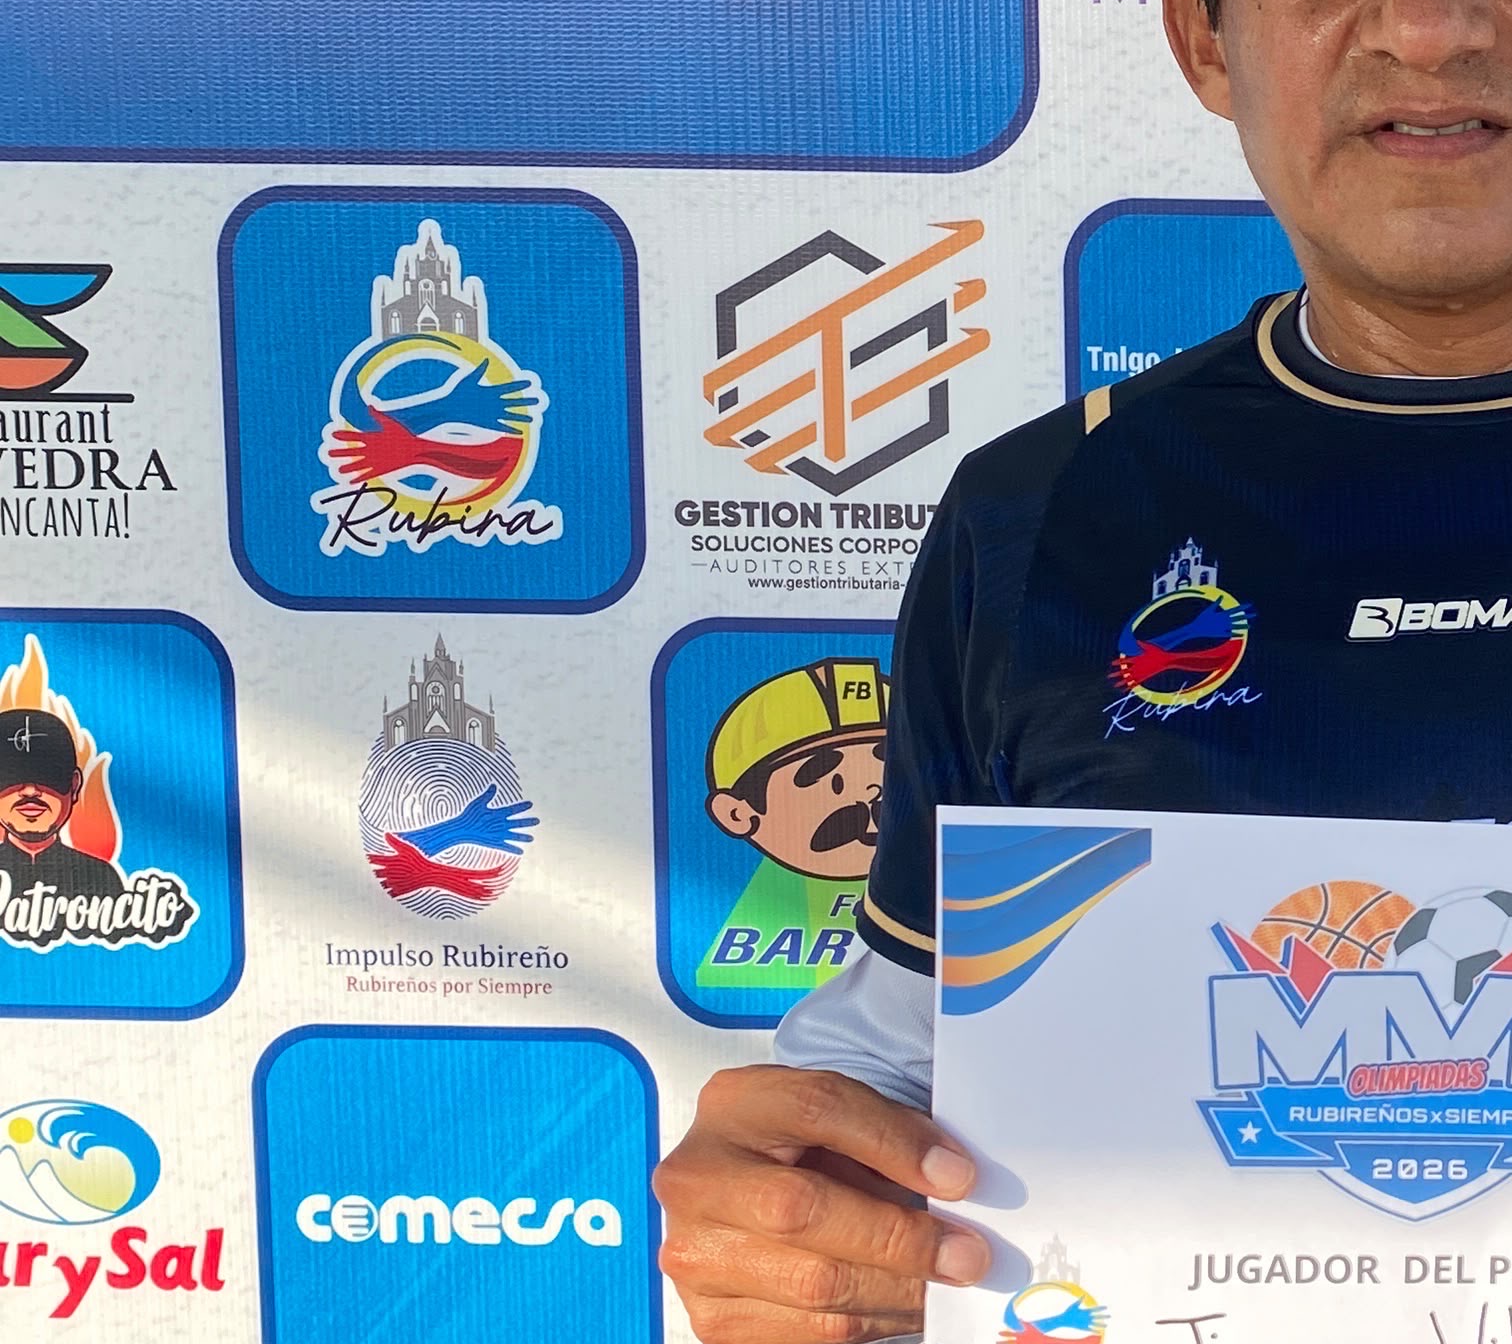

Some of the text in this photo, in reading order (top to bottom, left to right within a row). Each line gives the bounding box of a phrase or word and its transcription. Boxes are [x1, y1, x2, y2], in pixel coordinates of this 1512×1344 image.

[0, 447, 178, 492] EDRA
[0, 492, 130, 539] NCANTA!
[674, 500, 940, 530] GESTION TRIBU
[691, 535, 924, 555] SOLUCIONES CORPO
[709, 559, 848, 575] AUDITORES
[747, 575, 906, 592] www.gestiontributaria-
[842, 682, 871, 700] FB
[325, 943, 569, 972] Impulso Rubireño
[711, 928, 856, 967] BAR
[346, 976, 552, 998] Rubireños por Siempre
[1349, 1060, 1489, 1096] OLIMPIADAS
[1372, 1158, 1469, 1181] 2026
[1188, 1253, 1381, 1290] JUGADOR
[1404, 1255, 1476, 1285] DEL
